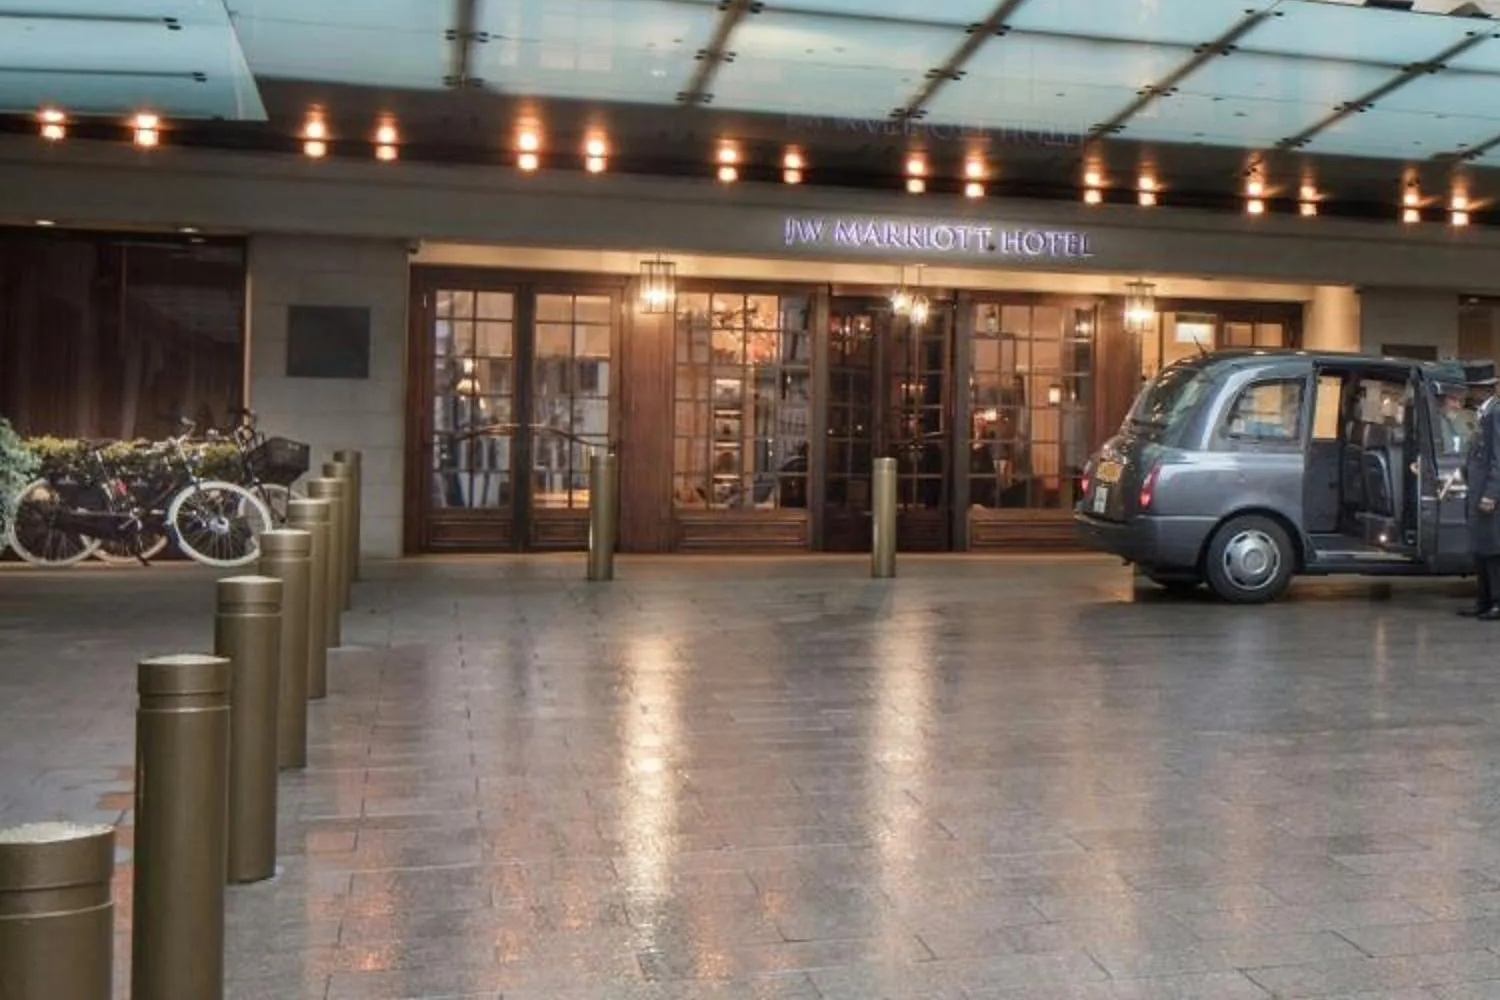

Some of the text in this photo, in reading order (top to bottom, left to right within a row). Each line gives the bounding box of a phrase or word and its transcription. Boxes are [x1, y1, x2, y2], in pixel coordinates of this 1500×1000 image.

[785, 218, 1095, 257] JW MARRIOTT HOTEL
